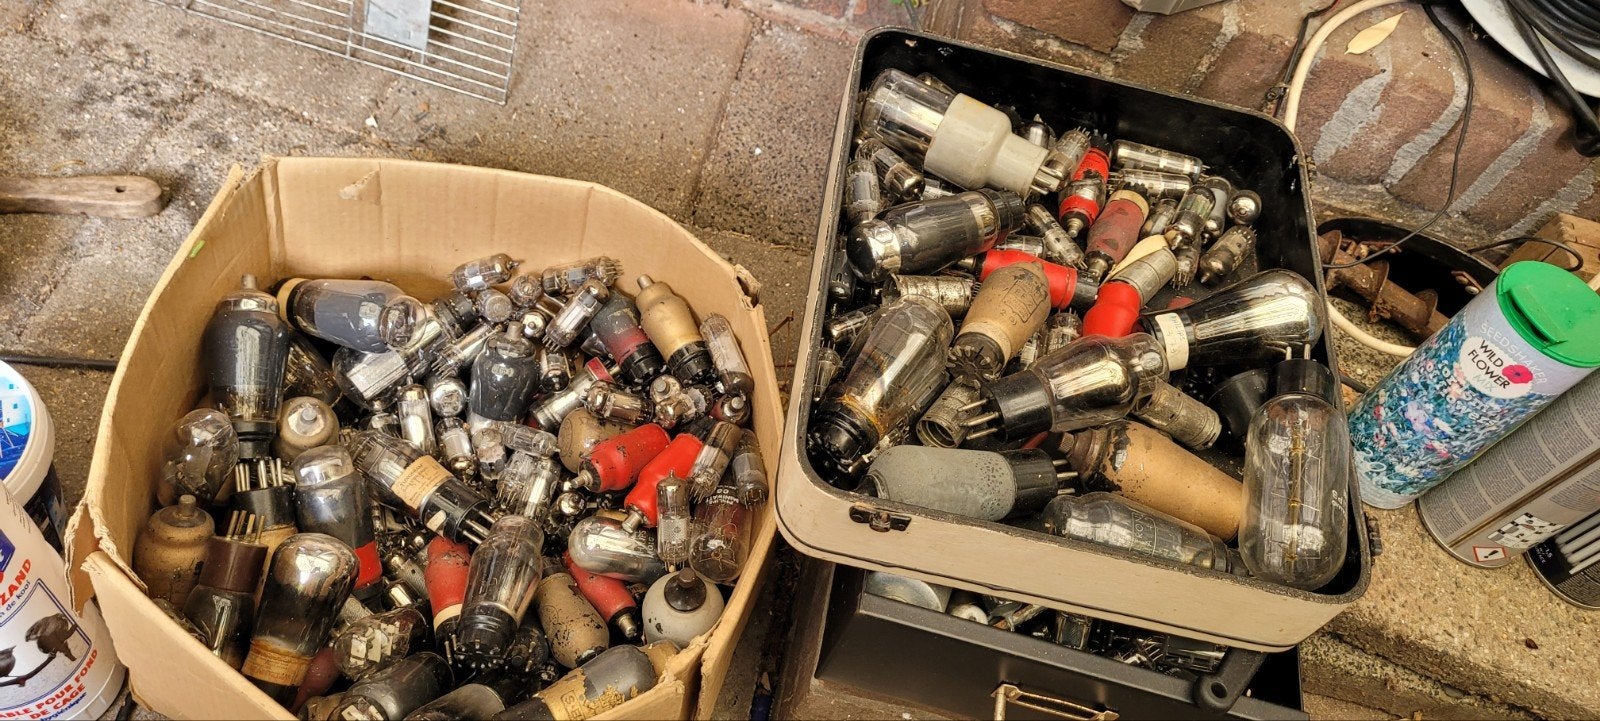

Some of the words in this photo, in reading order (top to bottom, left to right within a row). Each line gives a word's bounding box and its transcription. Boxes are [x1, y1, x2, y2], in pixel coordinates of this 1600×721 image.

[1468, 349, 1511, 389] FLOWER
[1479, 340, 1504, 368] WILD
[1480, 322, 1548, 384] SEEDSHAKER
[705, 494, 739, 504] MINIWATT
[0, 558, 31, 606] ZAND
[6, 601, 16, 611] de
[16, 580, 31, 600] kooi
[0, 707, 33, 718] ABLE
[36, 684, 73, 710] POUR
[74, 649, 97, 683] FOND
[29, 708, 51, 719] DE
[53, 683, 86, 710] CAGE
